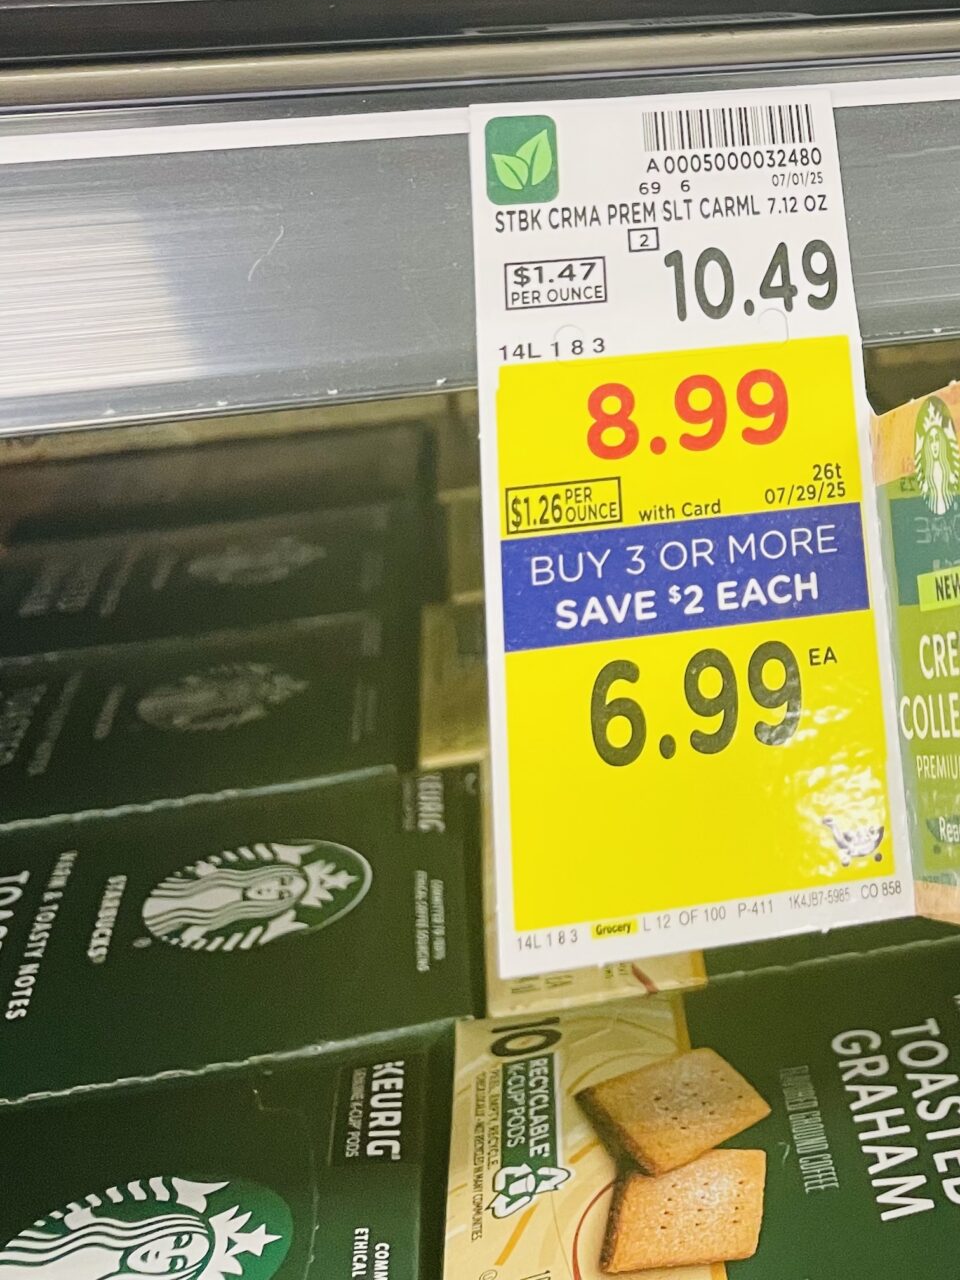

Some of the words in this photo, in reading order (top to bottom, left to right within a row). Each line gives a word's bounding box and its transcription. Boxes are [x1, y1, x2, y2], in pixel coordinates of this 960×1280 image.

[639, 180, 661, 195] 69
[680, 179, 691, 192] 6
[771, 171, 824, 188] 07/01/25
[494, 210, 543, 234] STBK
[549, 205, 600, 231] CRMA
[608, 202, 656, 226] PREM
[662, 199, 693, 222] SLT
[700, 195, 761, 220] CARML
[767, 197, 798, 214] 7.12
[804, 194, 828, 212] OZ
[639, 234, 650, 248] 2
[511, 290, 541, 305] PER
[546, 285, 603, 303] OUNCE
[512, 262, 598, 288] $1.47
[663, 238, 838, 322] 10.49
[499, 342, 541, 361] 14L
[592, 337, 606, 354] 3
[586, 368, 789, 460] 8.99
[510, 492, 563, 532] $1.26
[565, 487, 593, 504] PER
[565, 503, 618, 522] OUNCE
[638, 505, 676, 522] with
[681, 499, 722, 518] Card
[764, 481, 846, 505] 07/29/25
[530, 548, 612, 586] BUY
[626, 545, 646, 576] 3
[659, 538, 715, 571] OR
[728, 524, 838, 564] MORE
[555, 590, 657, 630] SAVE
[668, 584, 705, 615] $2
[717, 571, 819, 611] EACH
[590, 640, 802, 767] 6.99
[808, 646, 838, 666] EA
[24, 903, 59, 958] TOASTY
[517, 936, 541, 951] 14L
[596, 919, 632, 937] Grocery
[656, 914, 671, 929] 12
[679, 910, 698, 926] OF
[704, 906, 727, 922] 100
[737, 899, 774, 918] P-411
[860, 883, 879, 900] CO
[882, 880, 902, 896] 858
[5, 963, 40, 1020] NOTES
[490, 1016, 562, 1057] 10
[506, 1106, 526, 1148] PODS
[528, 1057, 551, 1158] RECYCLABLE
[831, 1029, 936, 1222] GRAHAM
[789, 1110, 829, 1155] GROUND
[799, 1153, 840, 1195] COFFEE
[352, 1227, 370, 1278] ETHICAL
